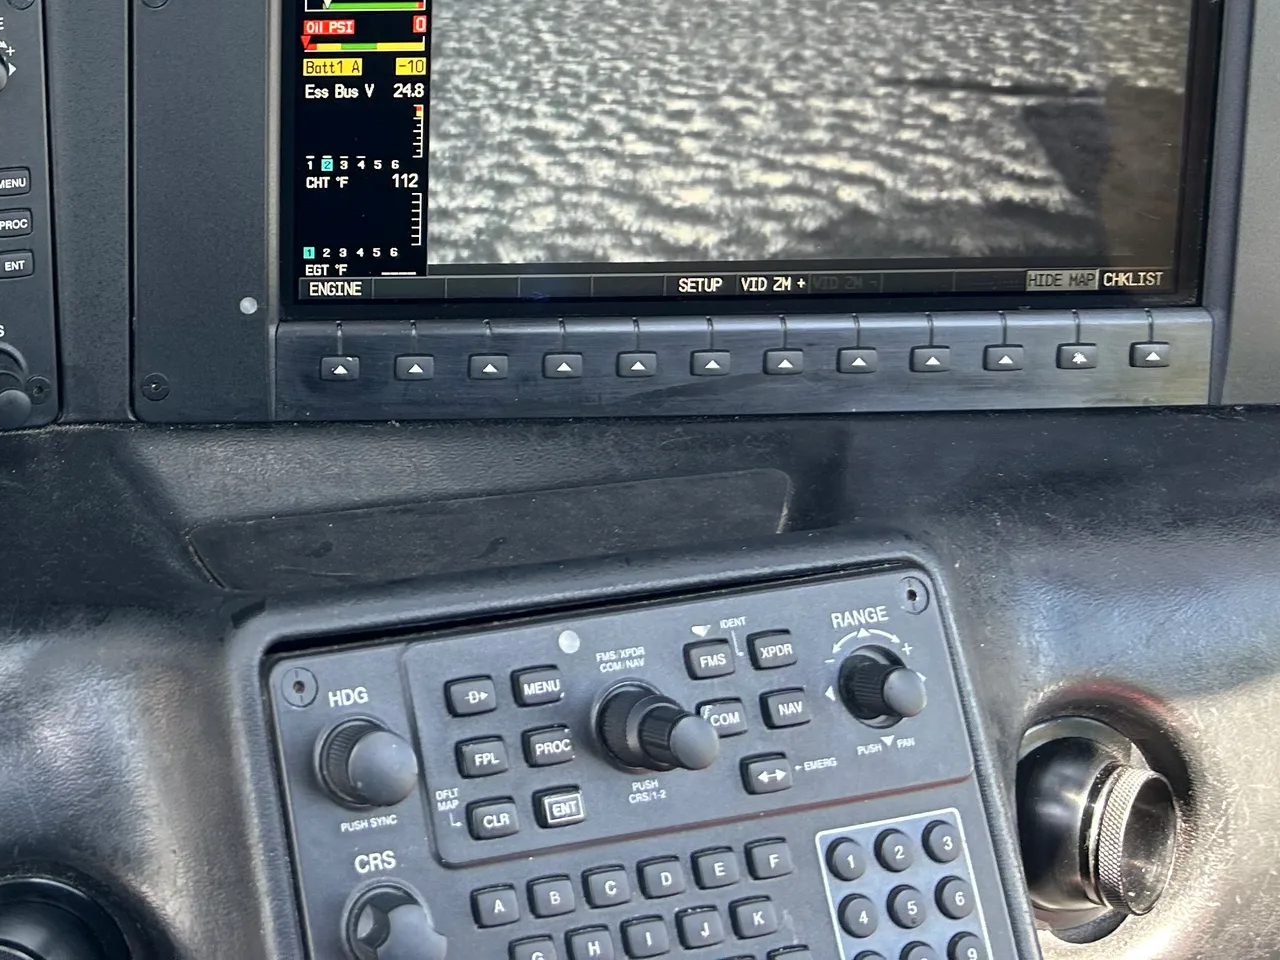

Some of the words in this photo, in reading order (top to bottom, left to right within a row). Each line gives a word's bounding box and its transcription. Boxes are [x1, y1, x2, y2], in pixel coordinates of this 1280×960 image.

[329, 21, 352, 33] PSI
[306, 61, 343, 74] Batt1
[393, 83, 425, 98] 24.8
[306, 177, 330, 188] CHT
[392, 173, 418, 187] 112
[0, 219, 28, 231] PROC
[5, 260, 25, 271] ENT
[305, 265, 329, 276] EGT
[309, 282, 362, 296] ENGINE
[678, 278, 723, 292] SETUP
[741, 277, 767, 291] VID
[773, 277, 792, 291] ZM
[1028, 273, 1062, 287] HIDE
[1069, 273, 1095, 286] MAP
[1103, 272, 1163, 286] CHKLIST
[720, 617, 747, 628] IDENT
[831, 606, 889, 628] RANGE
[760, 644, 793, 659] XPDR
[700, 654, 726, 668] FMS
[524, 679, 561, 695] MENU
[328, 687, 368, 708] HDG
[779, 701, 803, 715] NAV
[710, 711, 740, 726] COM
[536, 739, 571, 755] PROC
[475, 753, 500, 766] FPL
[552, 801, 577, 815] ENT
[341, 819, 369, 833] PUSH
[370, 815, 397, 828] SYNC
[483, 813, 510, 826] CLR
[354, 851, 396, 873] CRS
